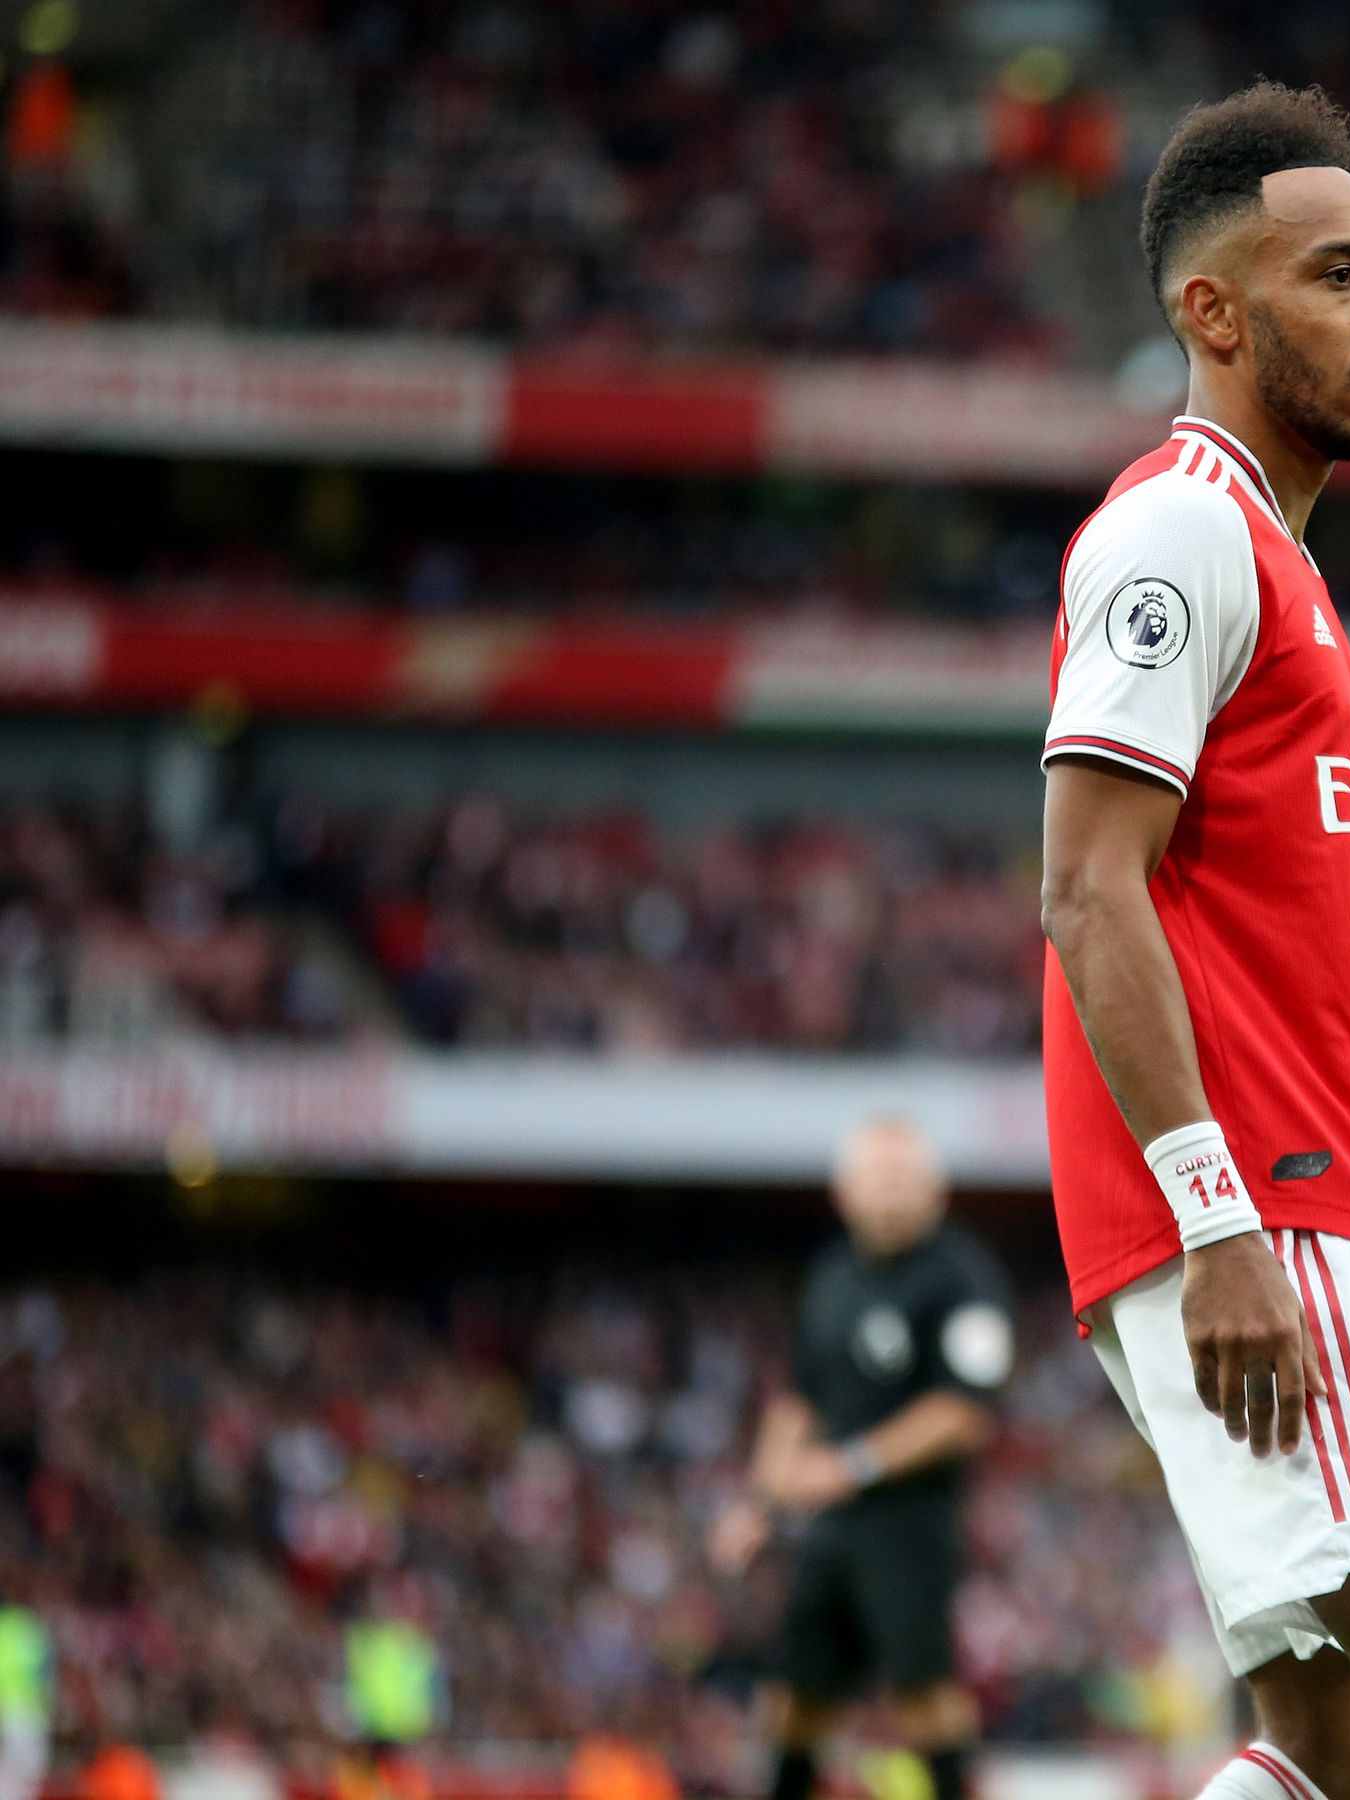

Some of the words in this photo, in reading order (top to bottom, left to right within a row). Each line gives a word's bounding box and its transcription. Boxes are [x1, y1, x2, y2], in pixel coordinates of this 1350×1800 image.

[1134, 650, 1160, 660] Premier
[1160, 632, 1178, 656] League
[1189, 1167, 1237, 1208] 14
